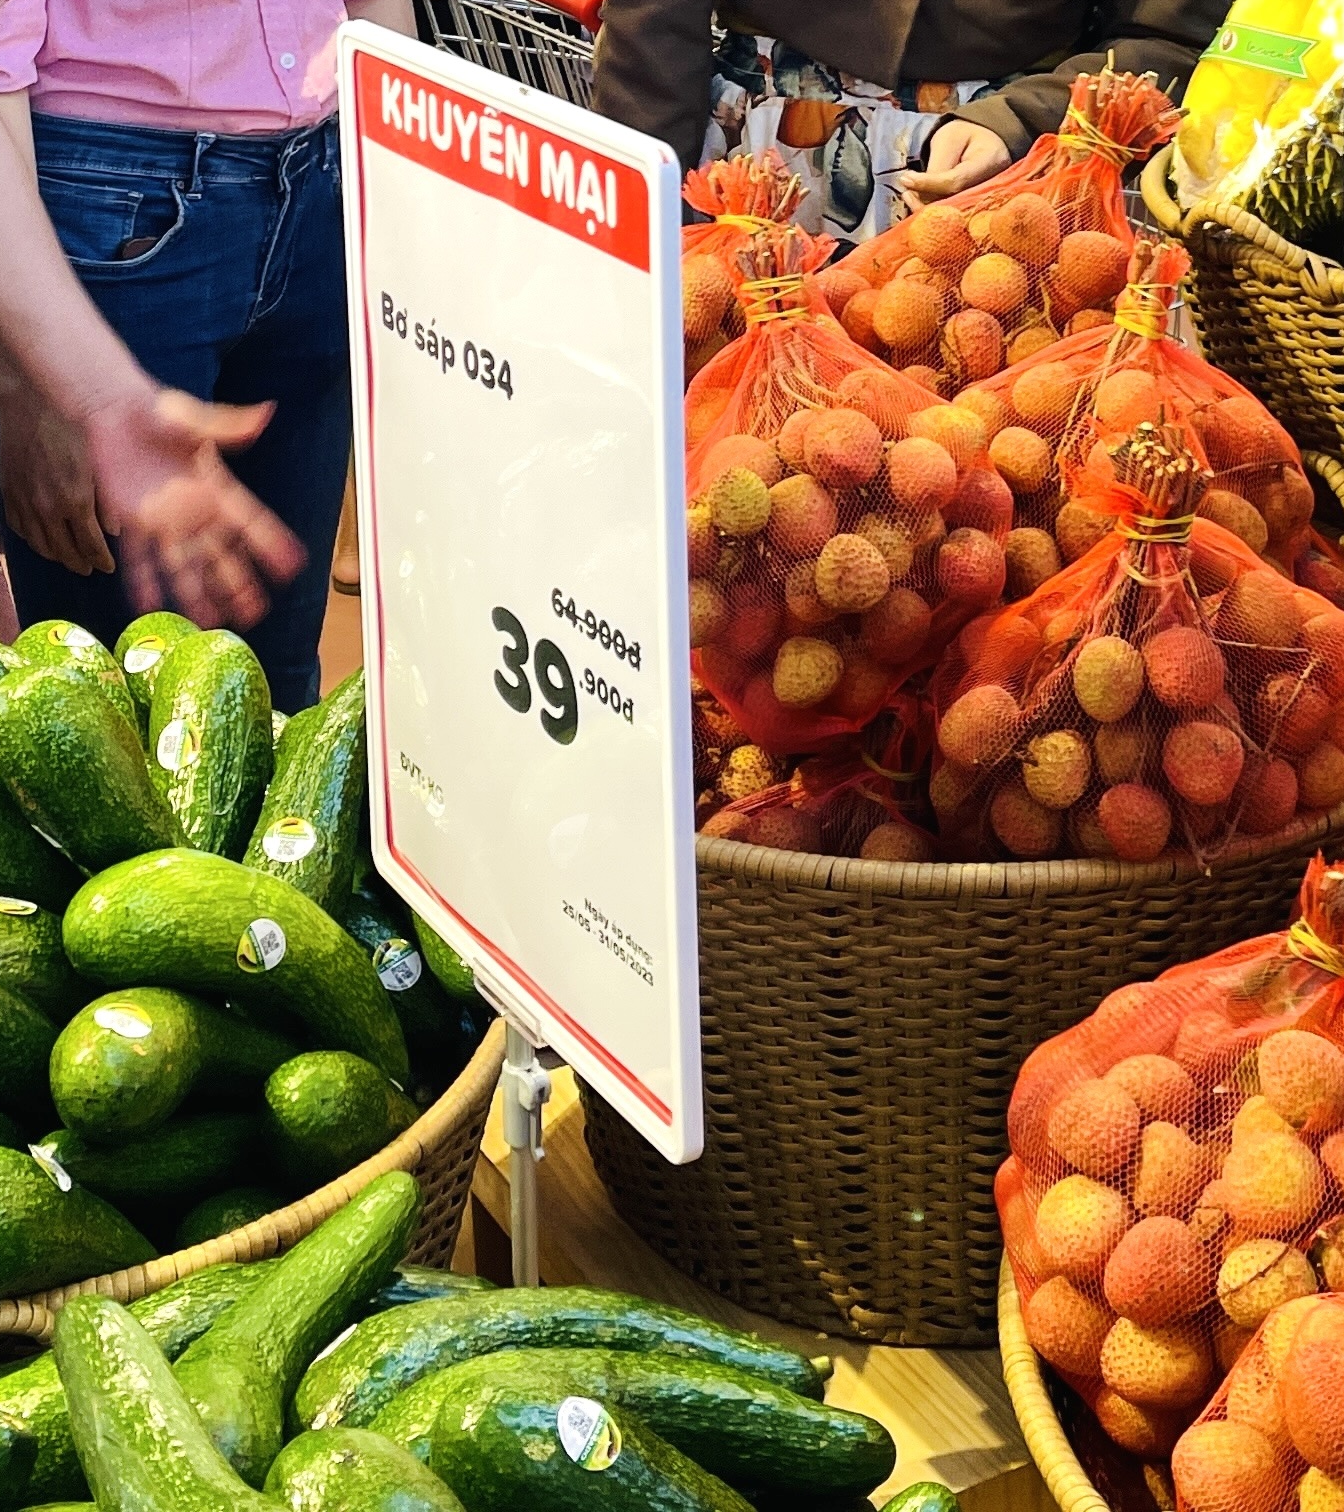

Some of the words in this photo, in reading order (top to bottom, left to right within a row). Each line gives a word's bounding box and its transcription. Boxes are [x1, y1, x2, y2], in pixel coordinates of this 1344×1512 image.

[540, 141, 617, 236] MẠI
[381, 290, 407, 340] Bơ
[415, 318, 455, 375] sáp
[463, 340, 514, 401] 034
[491, 606, 578, 746] 39
[552, 587, 641, 672] 64.900đ
[562, 899, 590, 932] 25/05
